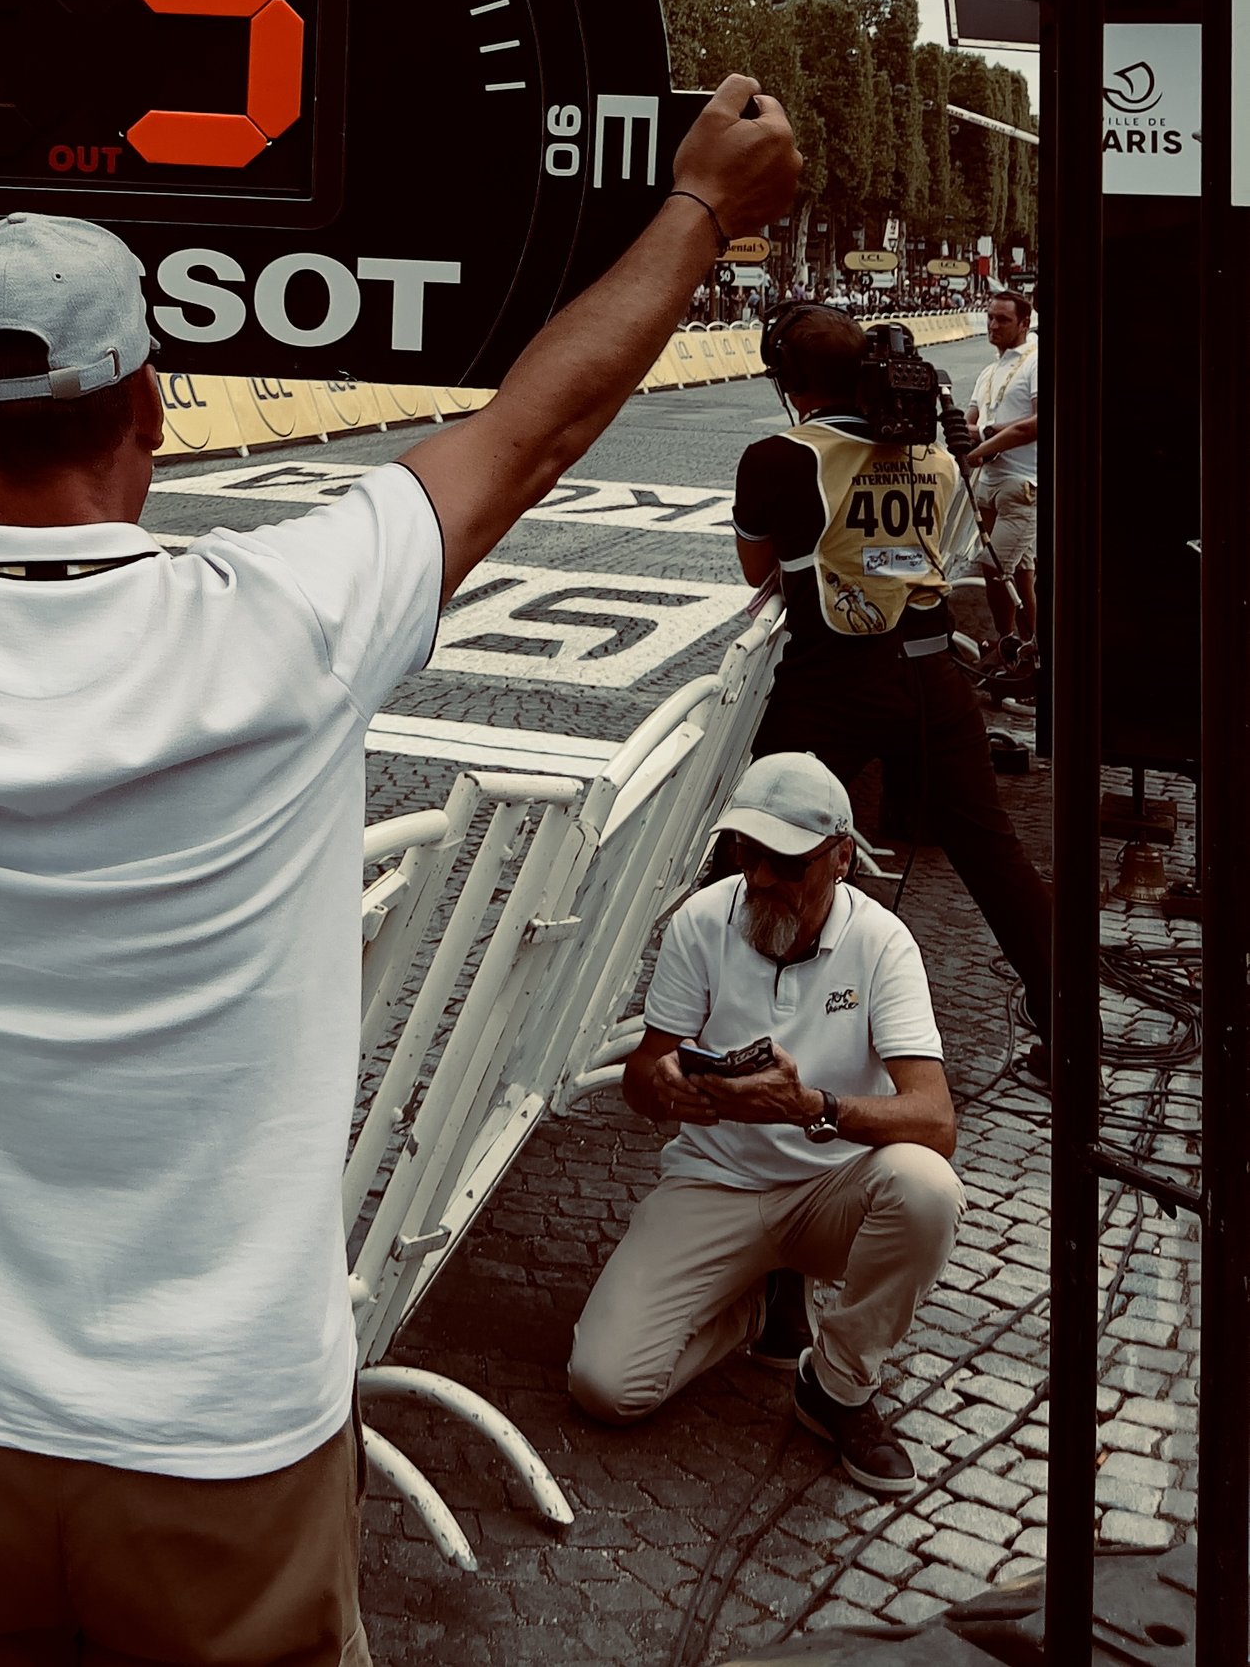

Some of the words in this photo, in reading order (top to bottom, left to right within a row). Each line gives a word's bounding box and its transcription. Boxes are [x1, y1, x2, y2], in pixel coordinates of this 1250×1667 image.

[1102, 117, 1139, 126] ILLE
[1148, 117, 1166, 127] DE
[546, 105, 581, 176] 90
[594, 95, 659, 188] E
[1102, 129, 1183, 155] ARIS
[49, 146, 122, 173] OUT
[157, 374, 207, 409] LCL
[846, 489, 935, 538] 404
